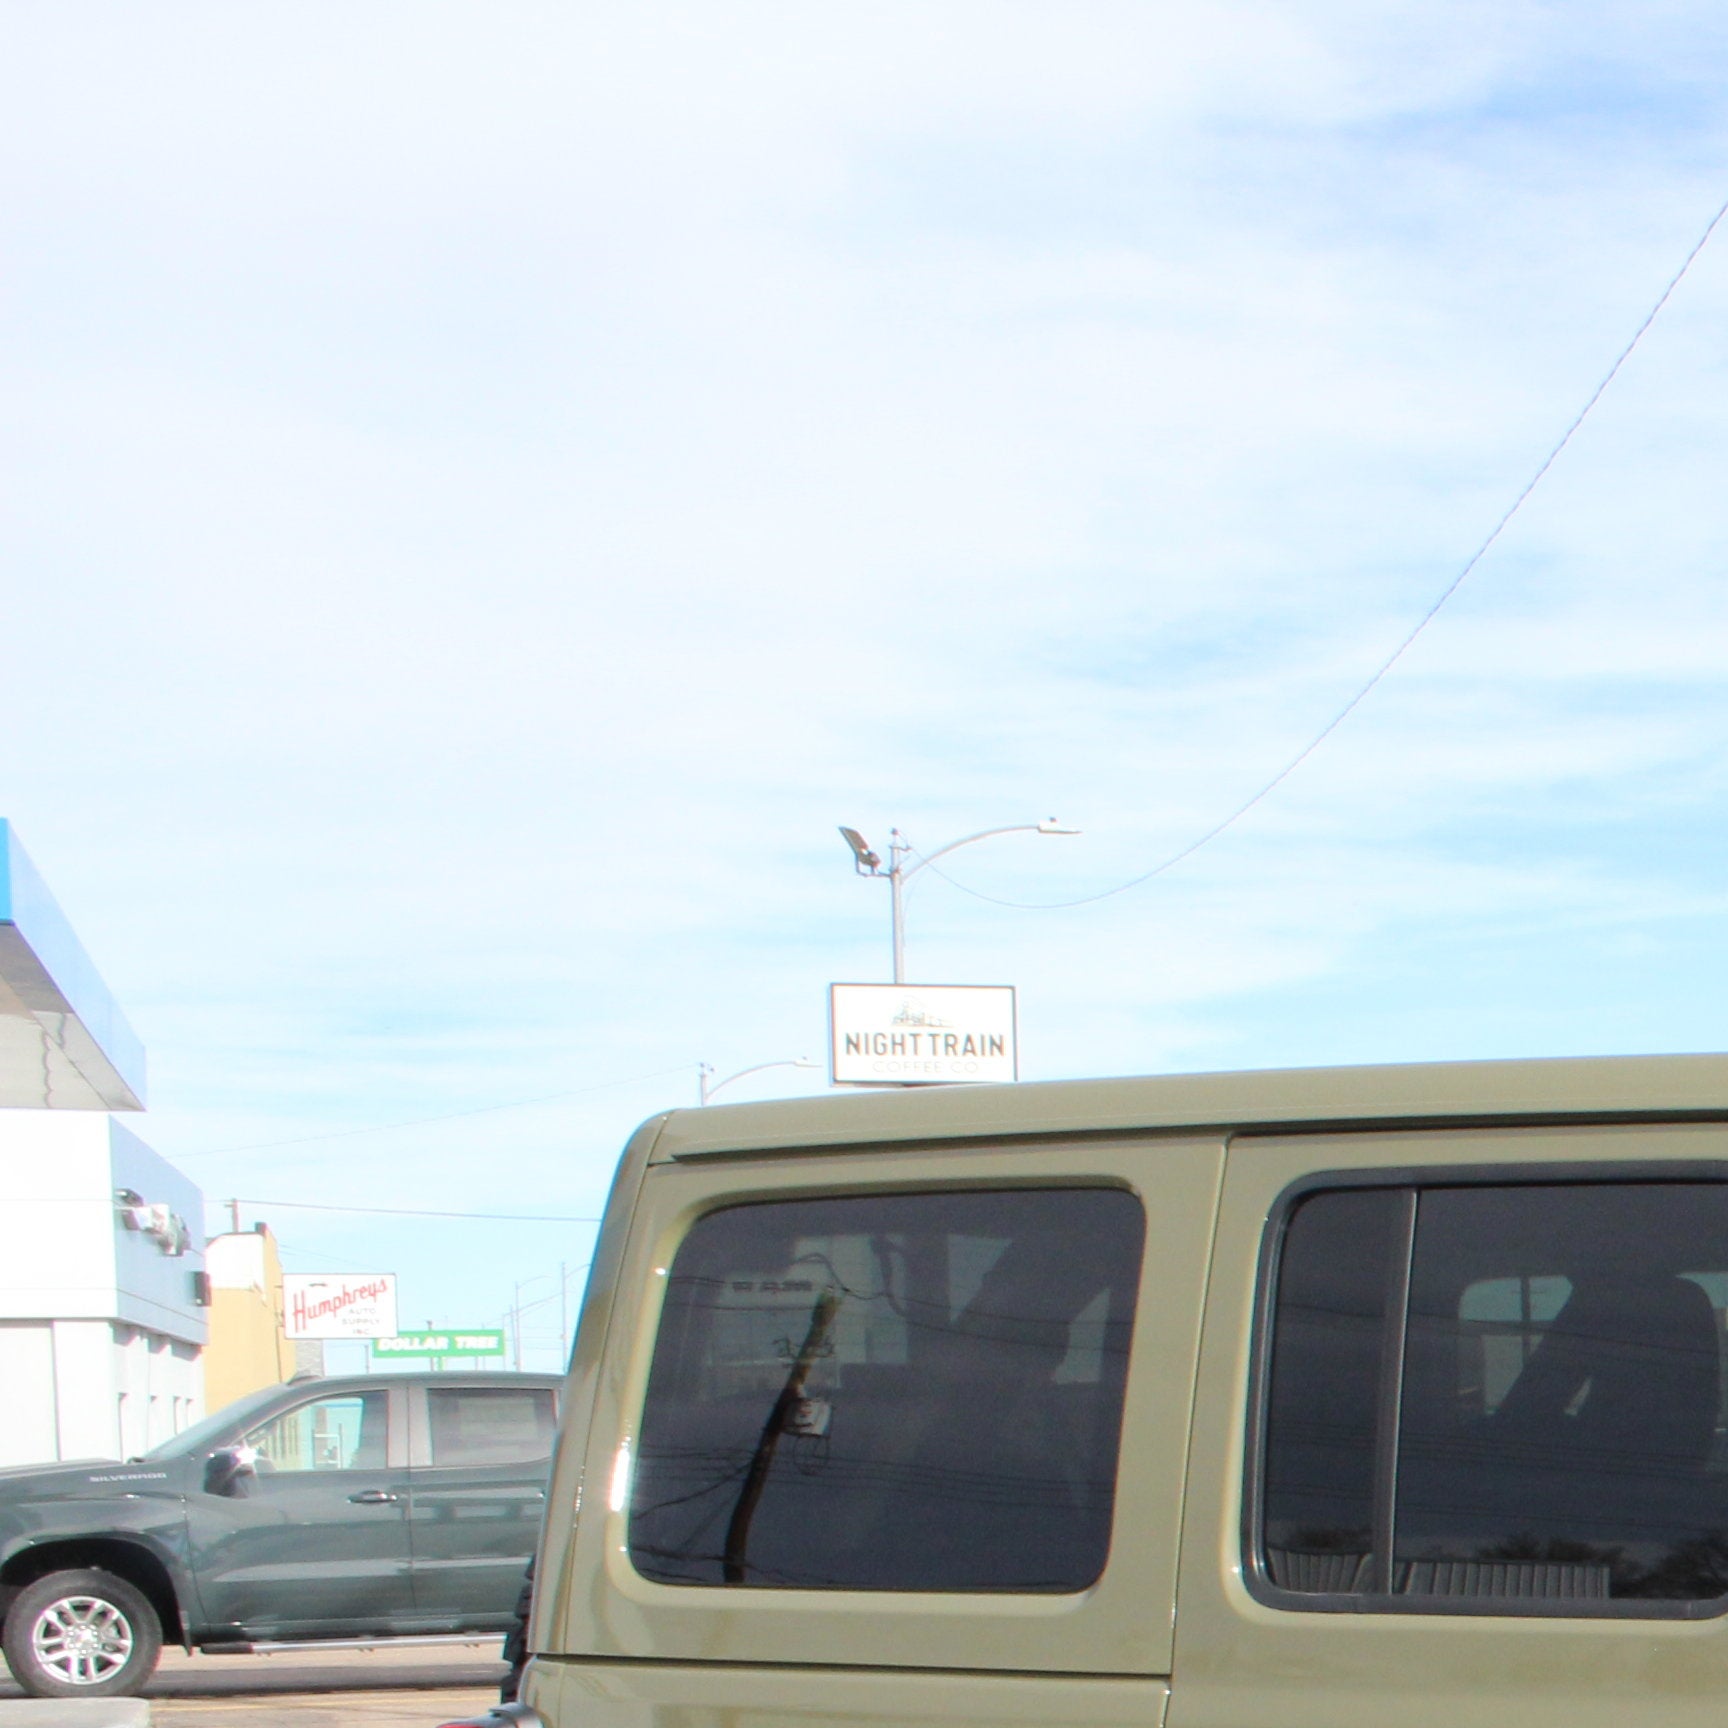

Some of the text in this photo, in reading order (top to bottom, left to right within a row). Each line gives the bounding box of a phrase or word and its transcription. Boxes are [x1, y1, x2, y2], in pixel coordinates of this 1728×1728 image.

[845, 1032, 1004, 1057] NIGHT TRAIN
[872, 1061, 978, 1073] COFFEE CO
[293, 1279, 388, 1333] Humphreys
[378, 1335, 499, 1351] DOLLAR TREE
[89, 1472, 167, 1482] SILVERADO
